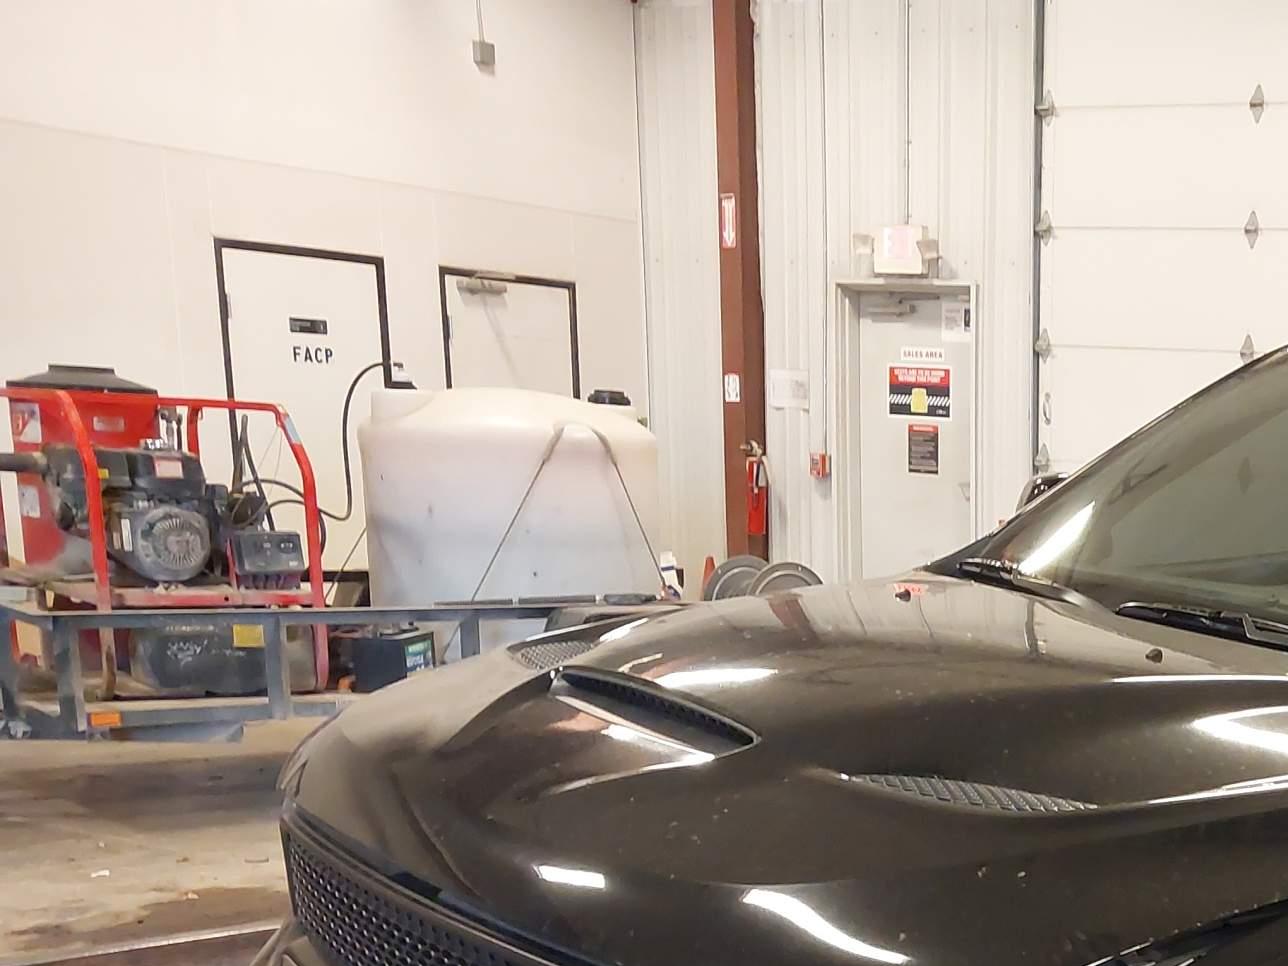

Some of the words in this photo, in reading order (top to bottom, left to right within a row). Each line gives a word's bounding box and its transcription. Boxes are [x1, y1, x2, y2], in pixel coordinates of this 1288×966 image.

[292, 345, 334, 364] FACP
[903, 349, 923, 359] SALES
[925, 350, 943, 359] AREA
